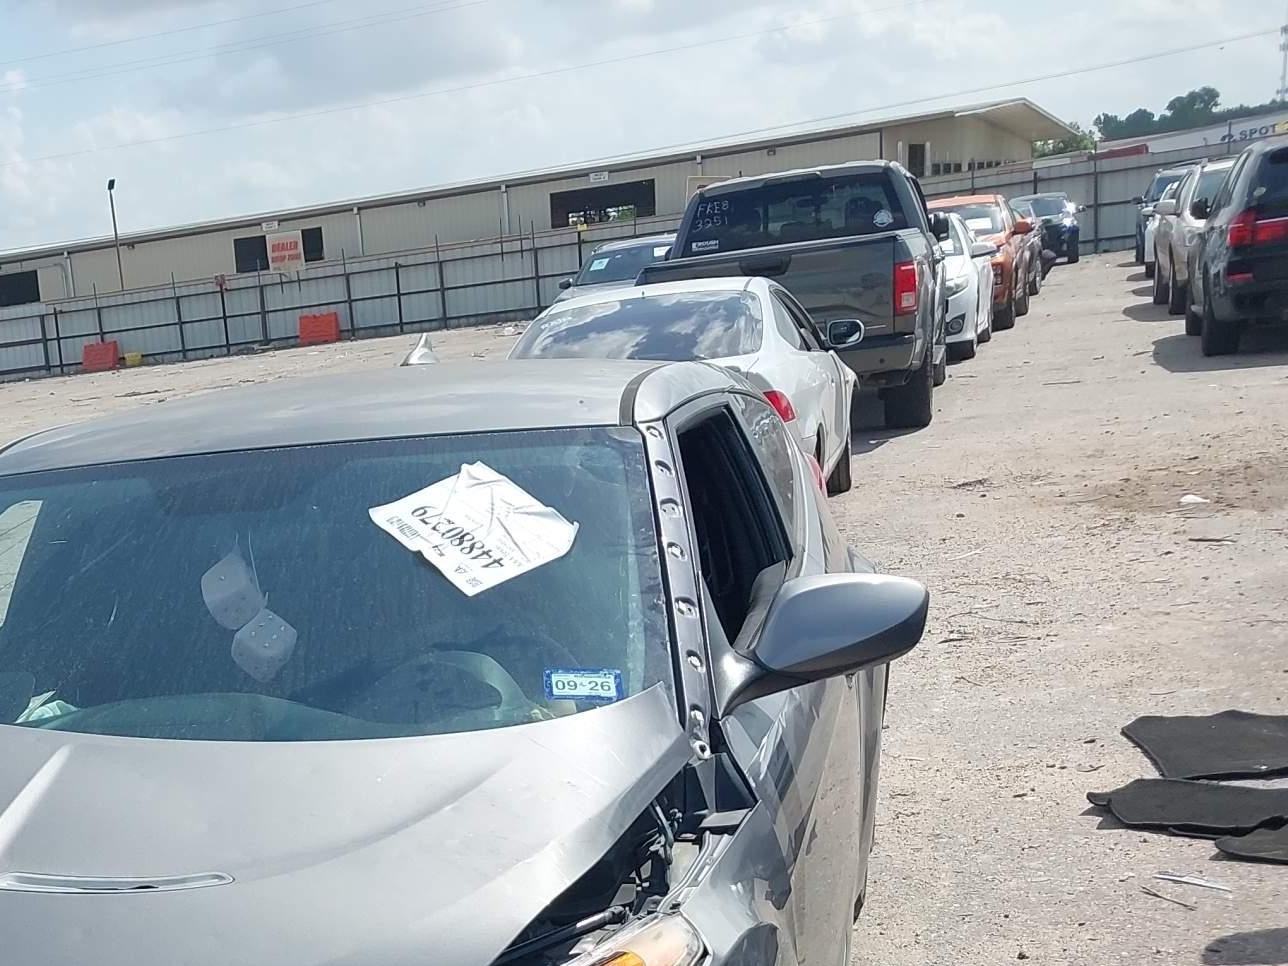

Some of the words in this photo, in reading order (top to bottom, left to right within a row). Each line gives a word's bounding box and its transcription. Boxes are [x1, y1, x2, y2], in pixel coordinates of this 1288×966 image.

[411, 505, 505, 569] 44880279
[555, 679, 578, 691] 09
[588, 680, 612, 692] 26
